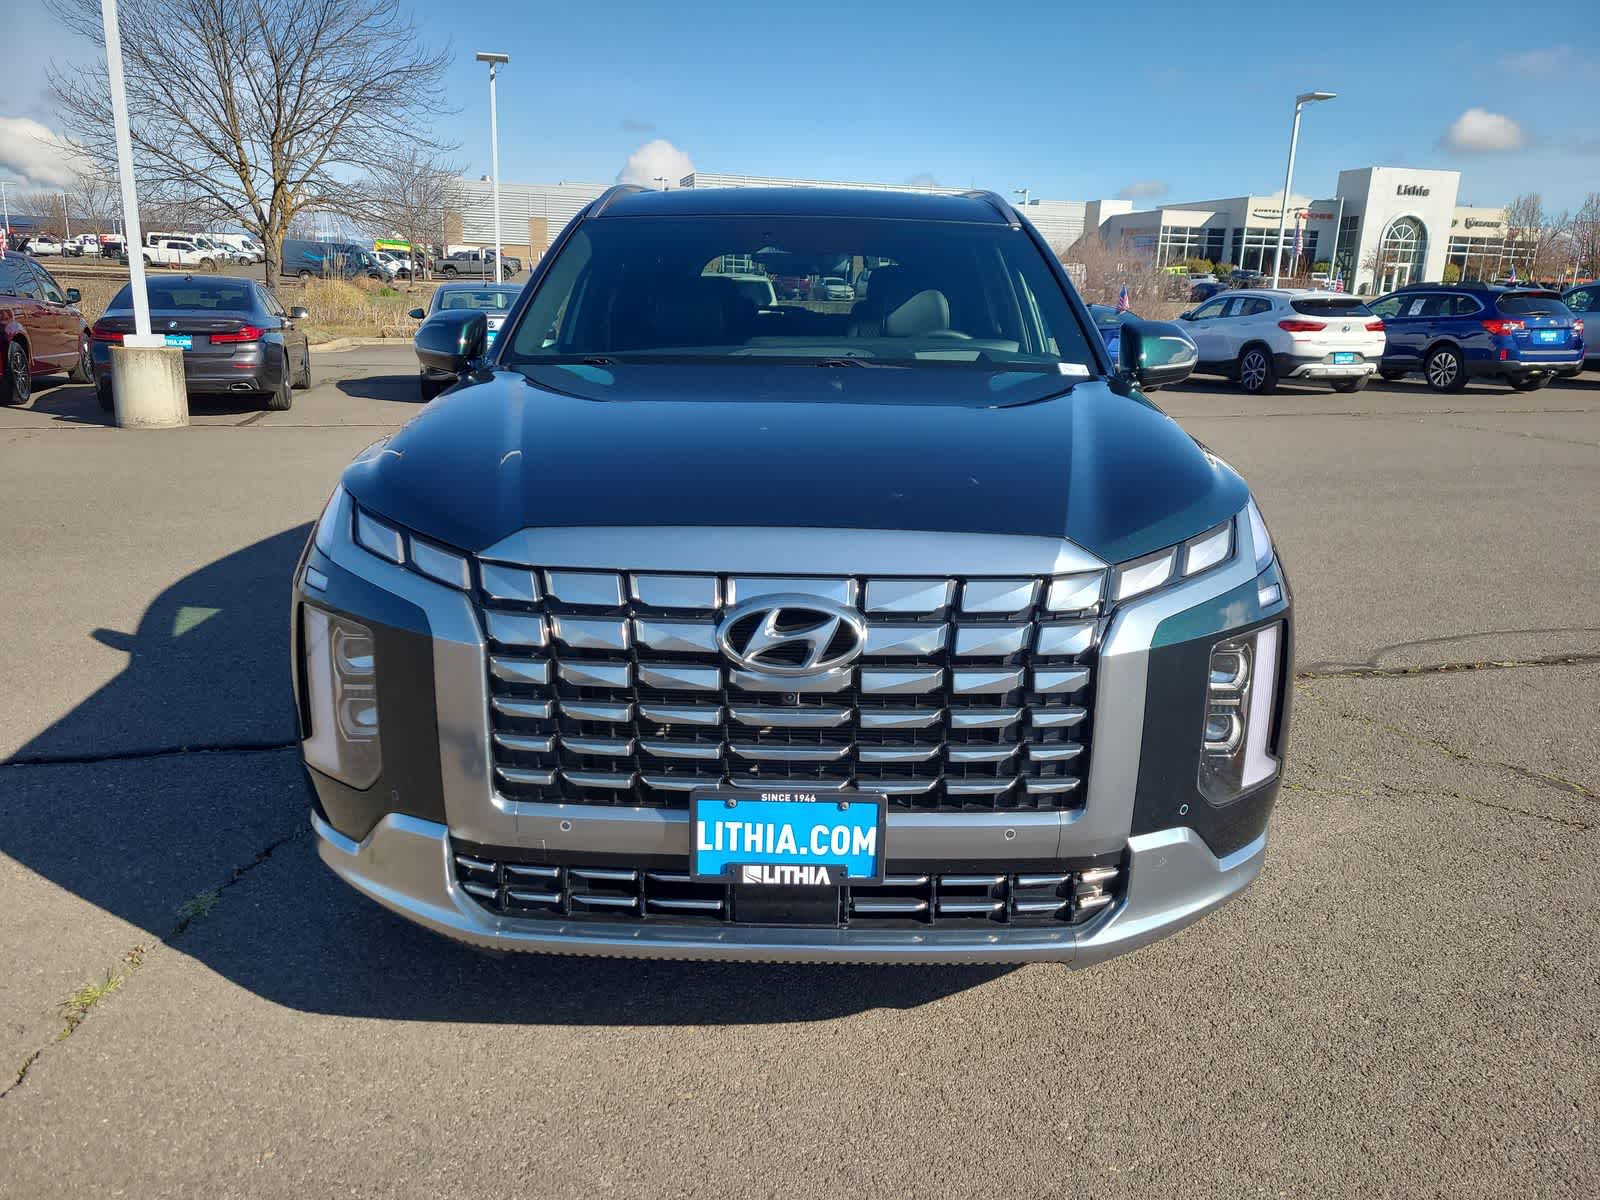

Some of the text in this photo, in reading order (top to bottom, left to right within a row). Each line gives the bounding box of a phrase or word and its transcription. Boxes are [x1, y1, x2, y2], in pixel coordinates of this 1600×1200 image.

[1396, 184, 1430, 197] Lithia
[761, 793, 816, 803] SINCE 1946
[697, 820, 877, 856] LITHIA.COM
[763, 865, 831, 885] LITHIA
